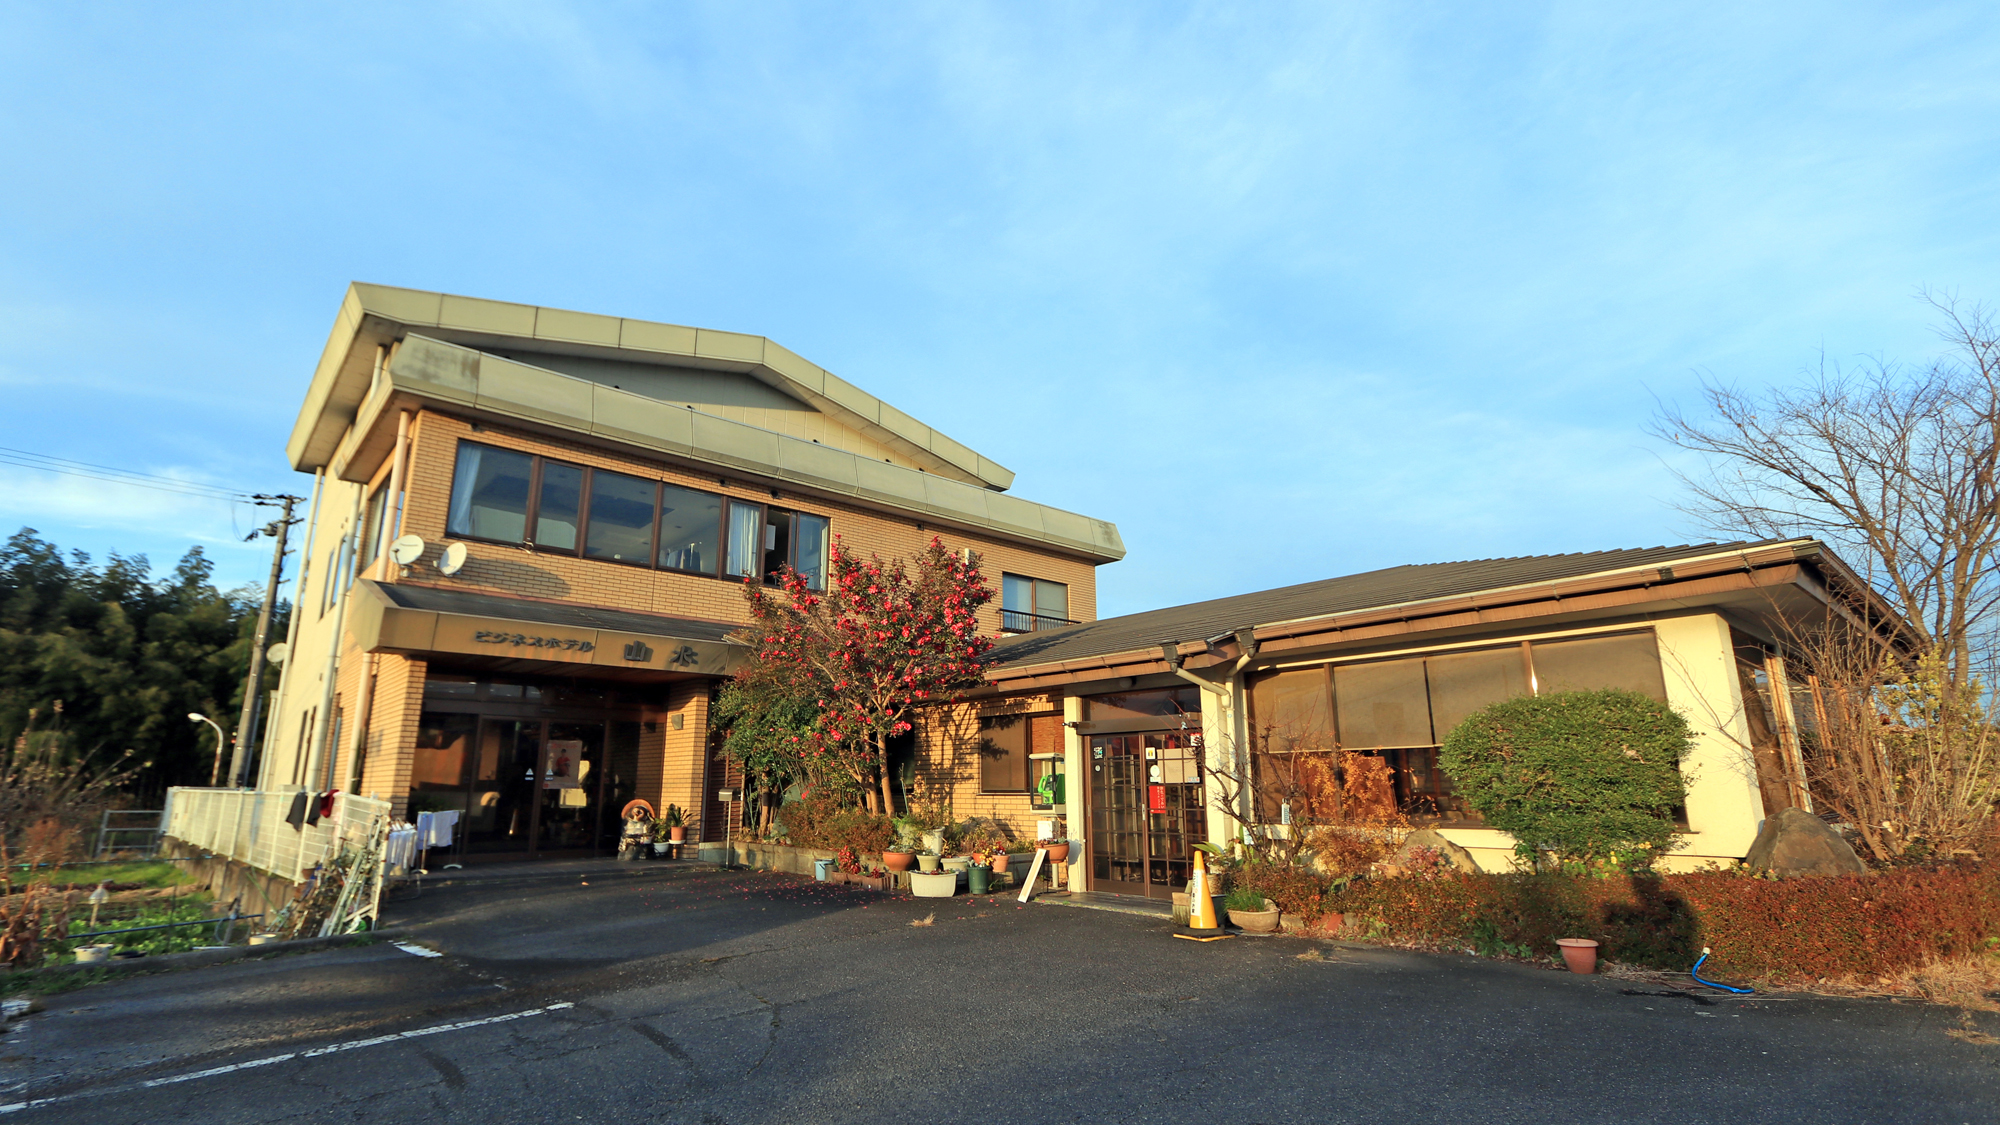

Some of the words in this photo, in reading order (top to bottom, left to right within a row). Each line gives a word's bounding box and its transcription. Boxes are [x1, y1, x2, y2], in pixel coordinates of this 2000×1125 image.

[475, 631, 595, 652] ビジネスホテル
[624, 640, 693, 666] 山水
